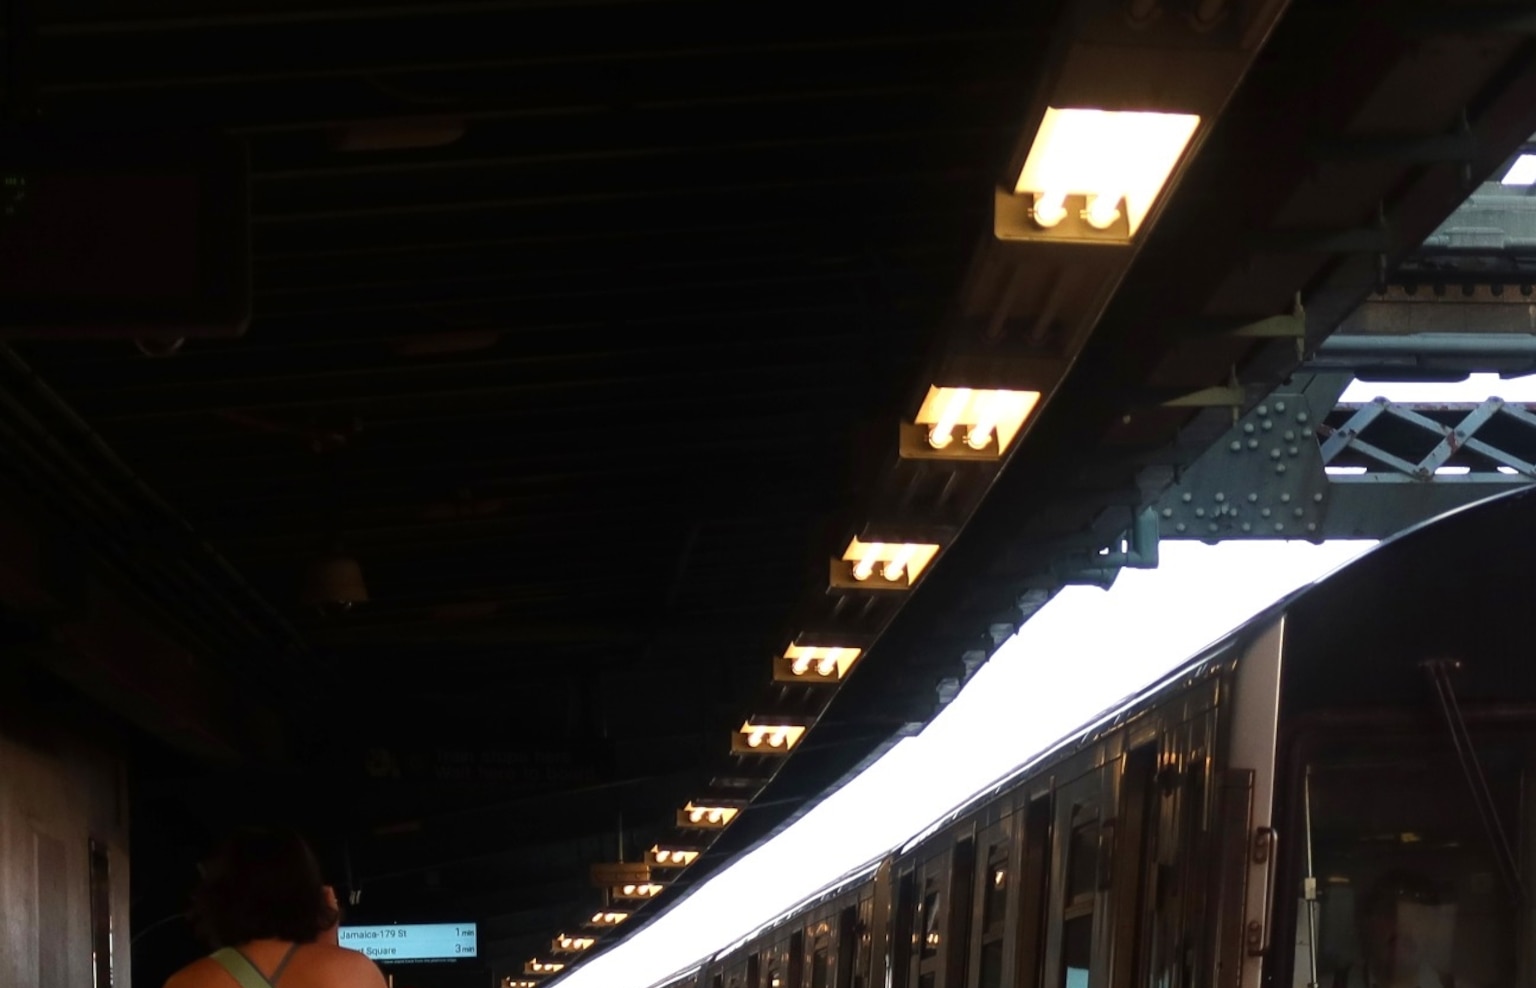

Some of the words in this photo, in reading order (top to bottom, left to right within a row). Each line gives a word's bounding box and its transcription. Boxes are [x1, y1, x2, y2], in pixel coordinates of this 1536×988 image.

[340, 930, 395, 940] Jamaica-179
[399, 930, 407, 938] St
[366, 946, 397, 956] Square
[455, 944, 461, 953] 3
